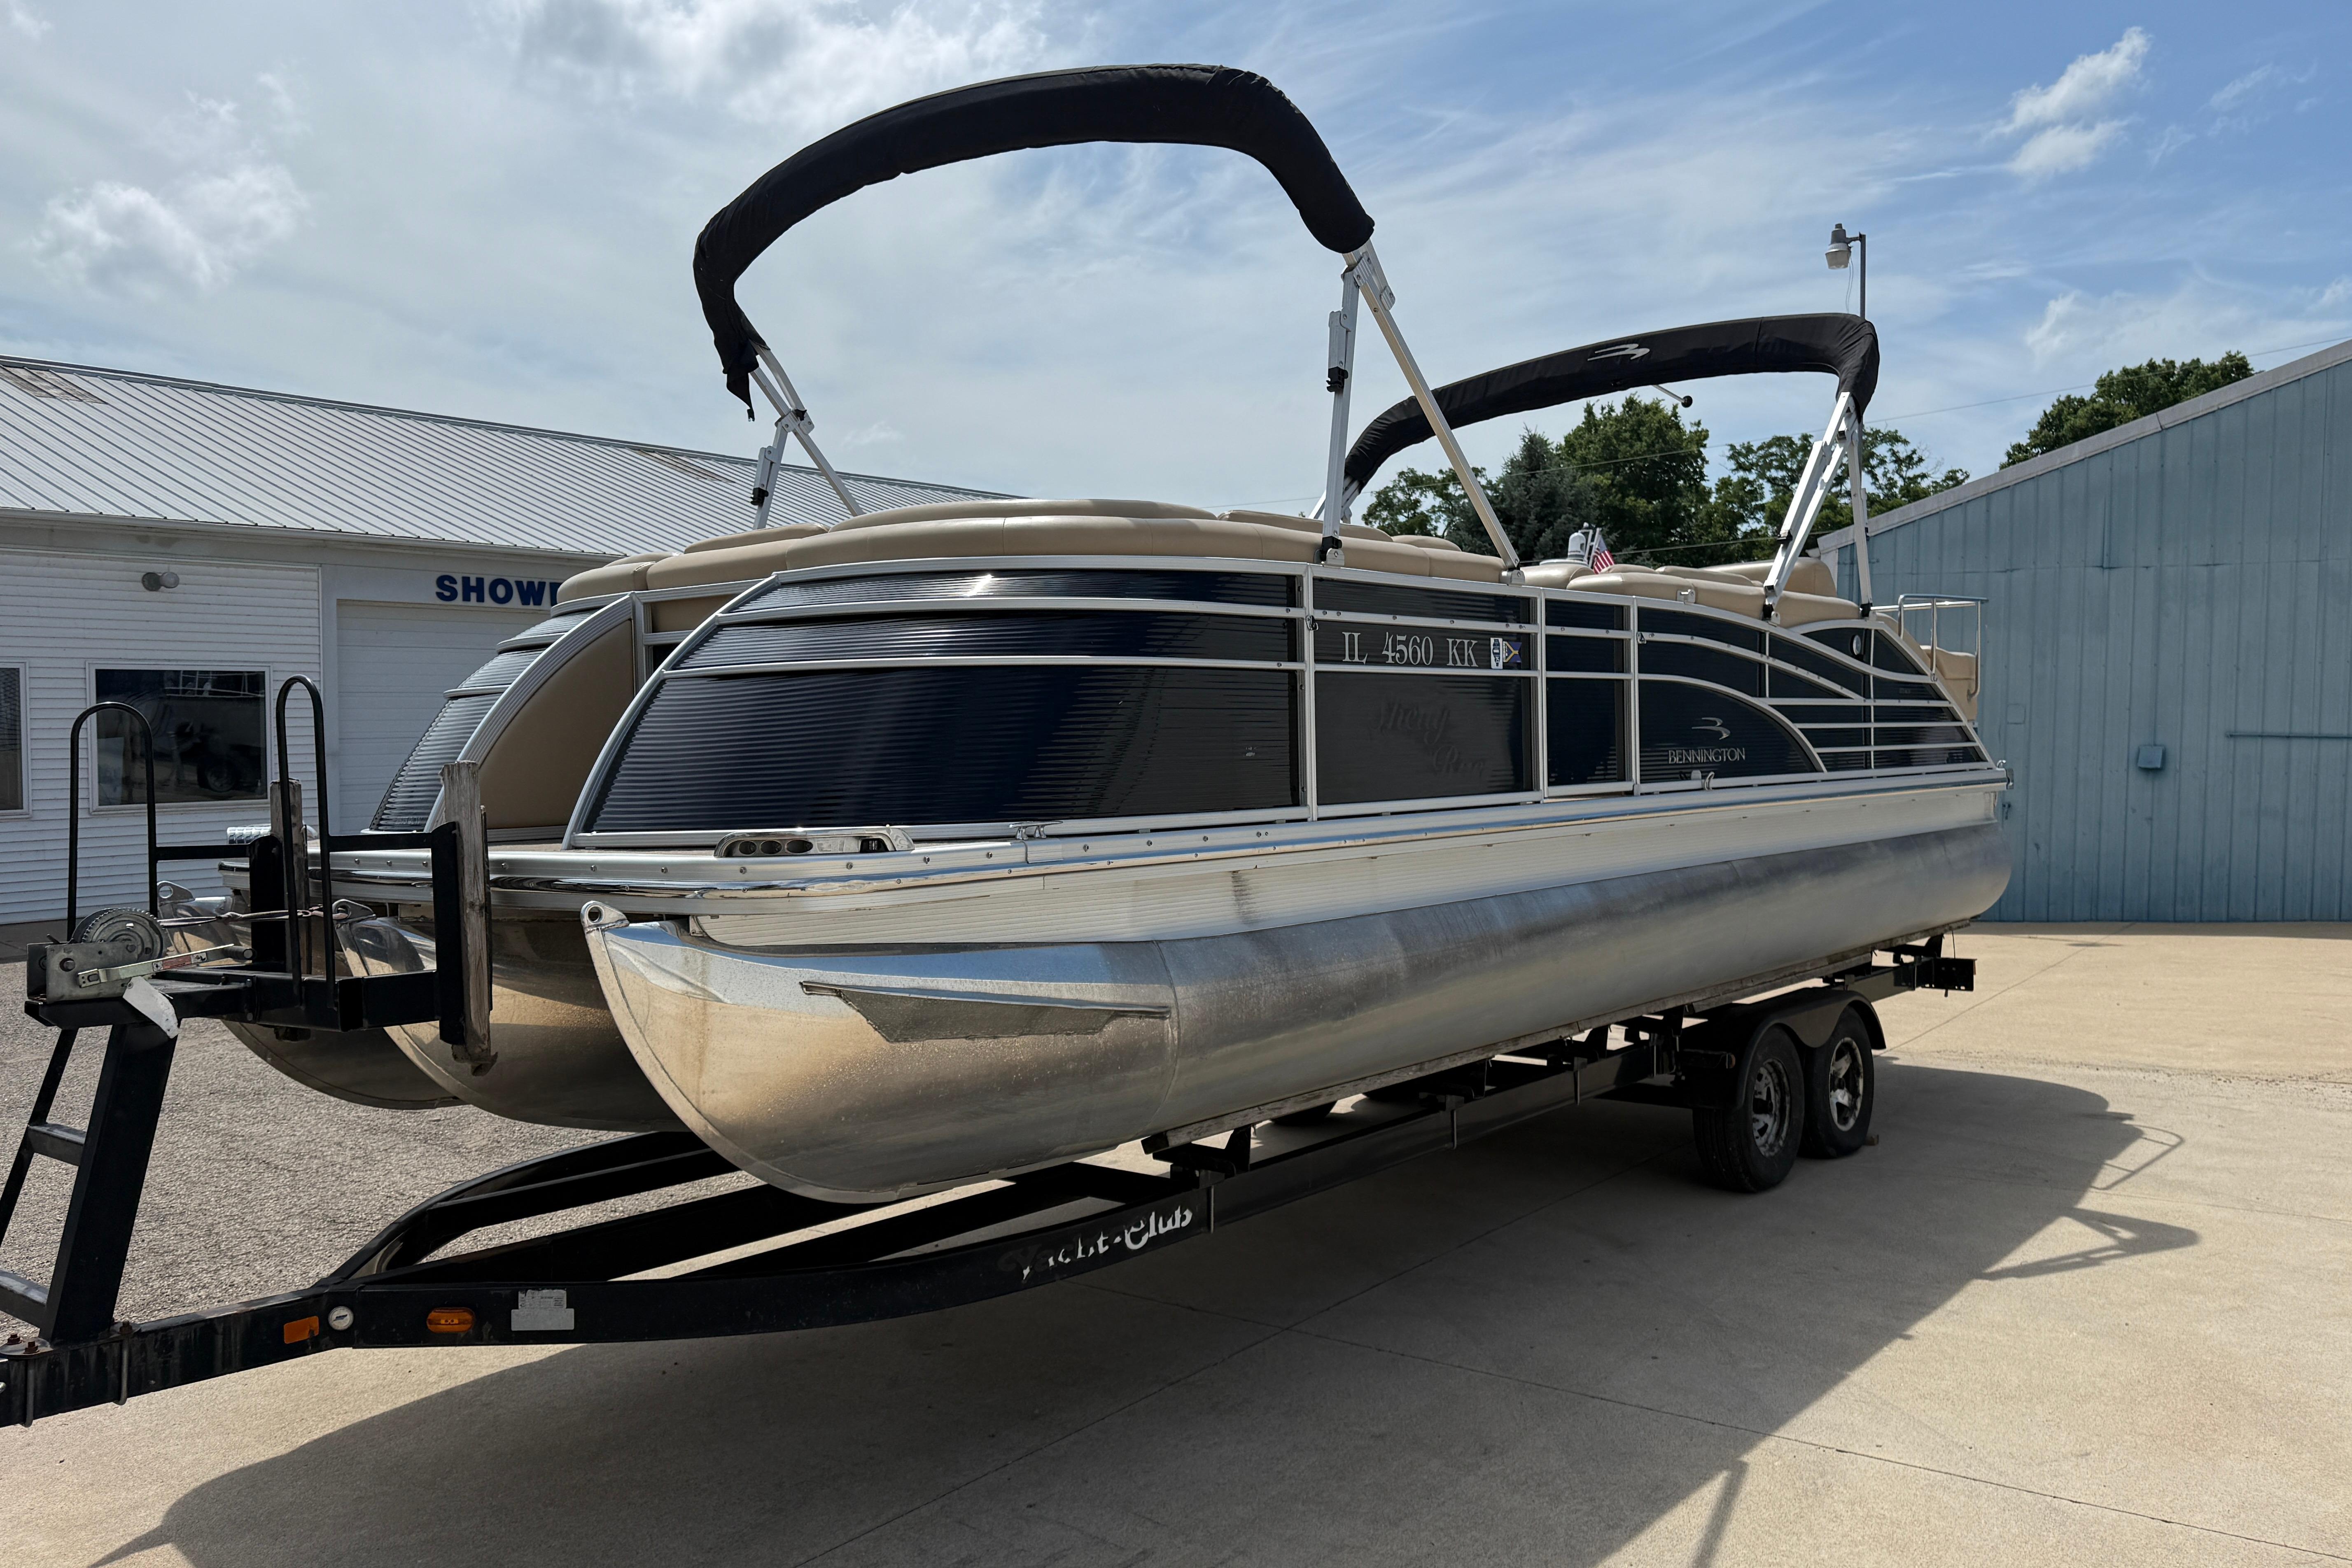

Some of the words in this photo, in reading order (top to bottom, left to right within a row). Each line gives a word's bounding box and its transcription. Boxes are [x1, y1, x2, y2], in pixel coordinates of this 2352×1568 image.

[1342, 632, 1367, 665] IL
[1382, 631, 1433, 665] 4560
[1446, 638, 1478, 667] KK
[1668, 747, 1745, 764] BENNINGTON
